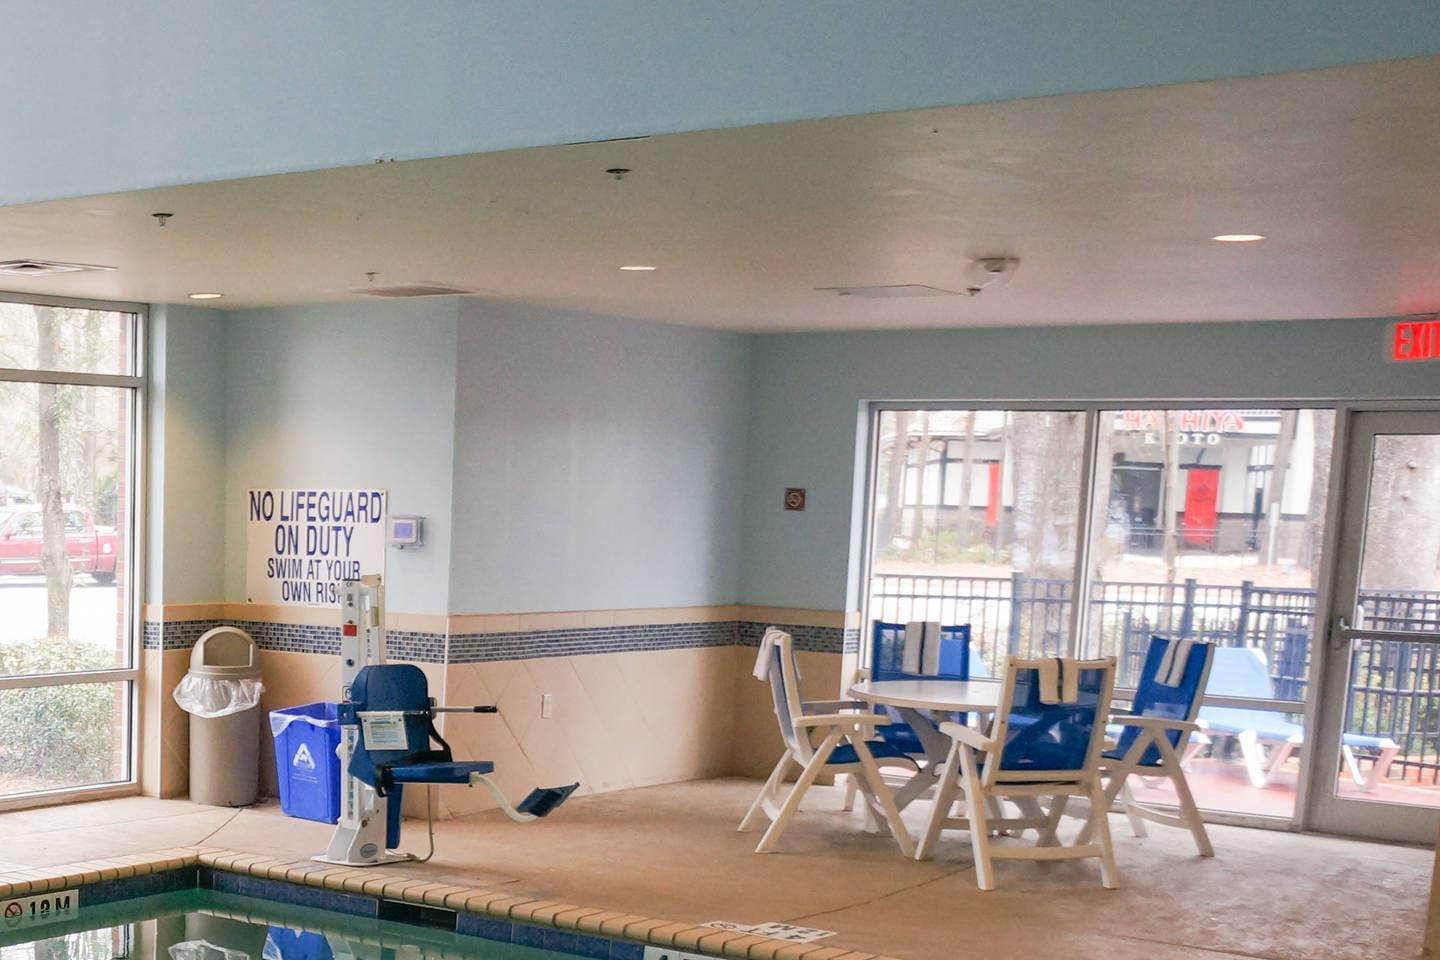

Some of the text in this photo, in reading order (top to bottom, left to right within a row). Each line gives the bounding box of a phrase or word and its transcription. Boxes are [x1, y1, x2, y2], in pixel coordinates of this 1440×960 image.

[1144, 432, 1221, 445] KOTO
[249, 491, 382, 523] NO LIFEGUARD
[275, 525, 354, 557] ON DUTY
[267, 558, 360, 581] SWIM AT YOUR
[282, 581, 311, 602] OWN
